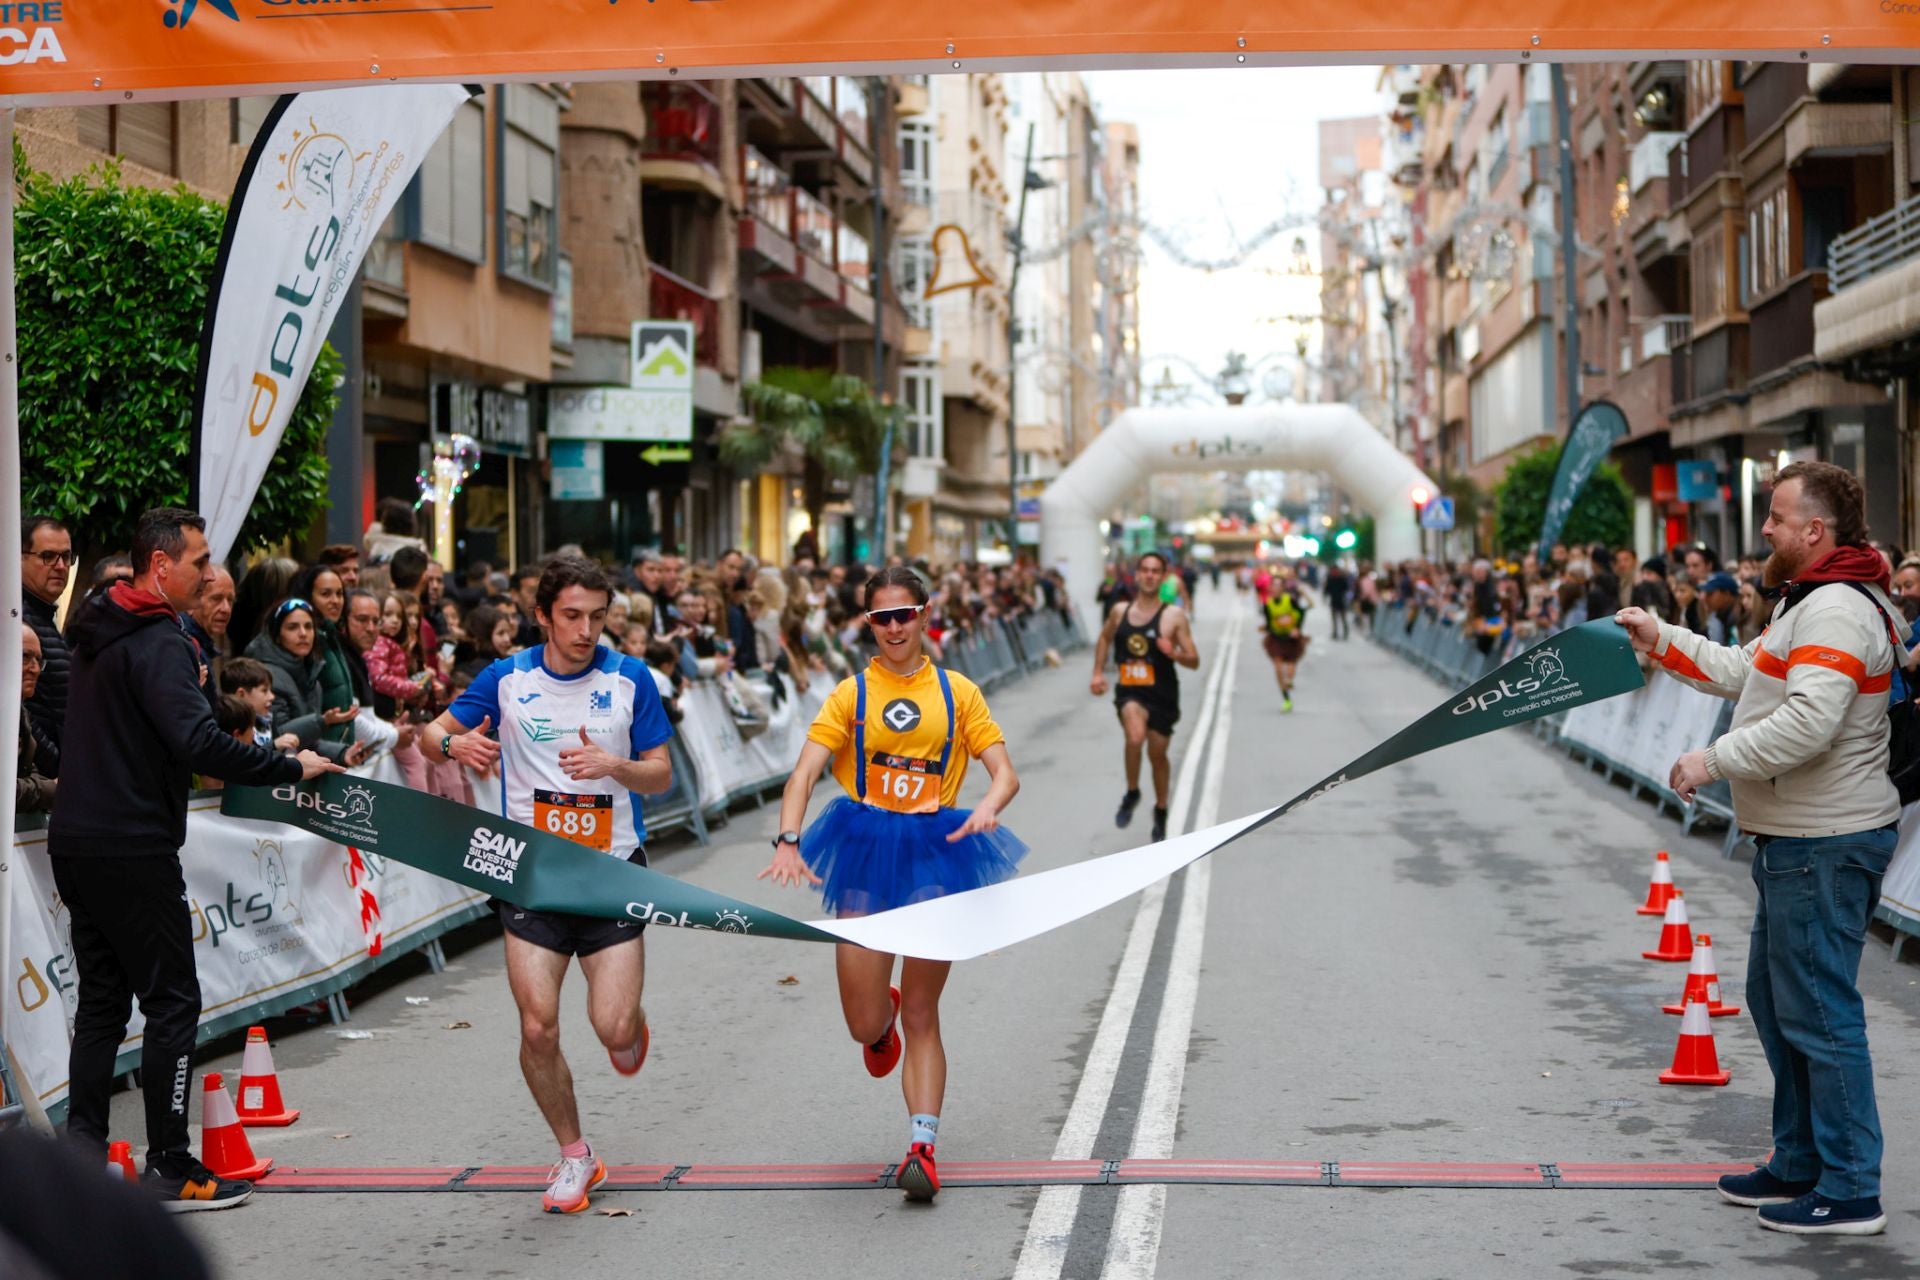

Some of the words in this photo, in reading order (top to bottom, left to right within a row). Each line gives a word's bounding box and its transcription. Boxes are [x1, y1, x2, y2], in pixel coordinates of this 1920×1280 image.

[248, 215, 340, 438] dpts
[1170, 436, 1263, 459] dpts
[1452, 677, 1541, 716] dpts
[1552, 690, 1583, 704] Deportes
[881, 771, 926, 800] 167
[272, 785, 347, 819] dpts
[546, 809, 597, 837] 689
[349, 831, 378, 845] Deportes
[470, 827, 527, 862] SAN
[463, 854, 514, 884] LORCA
[468, 846, 519, 871] SILVESTRE
